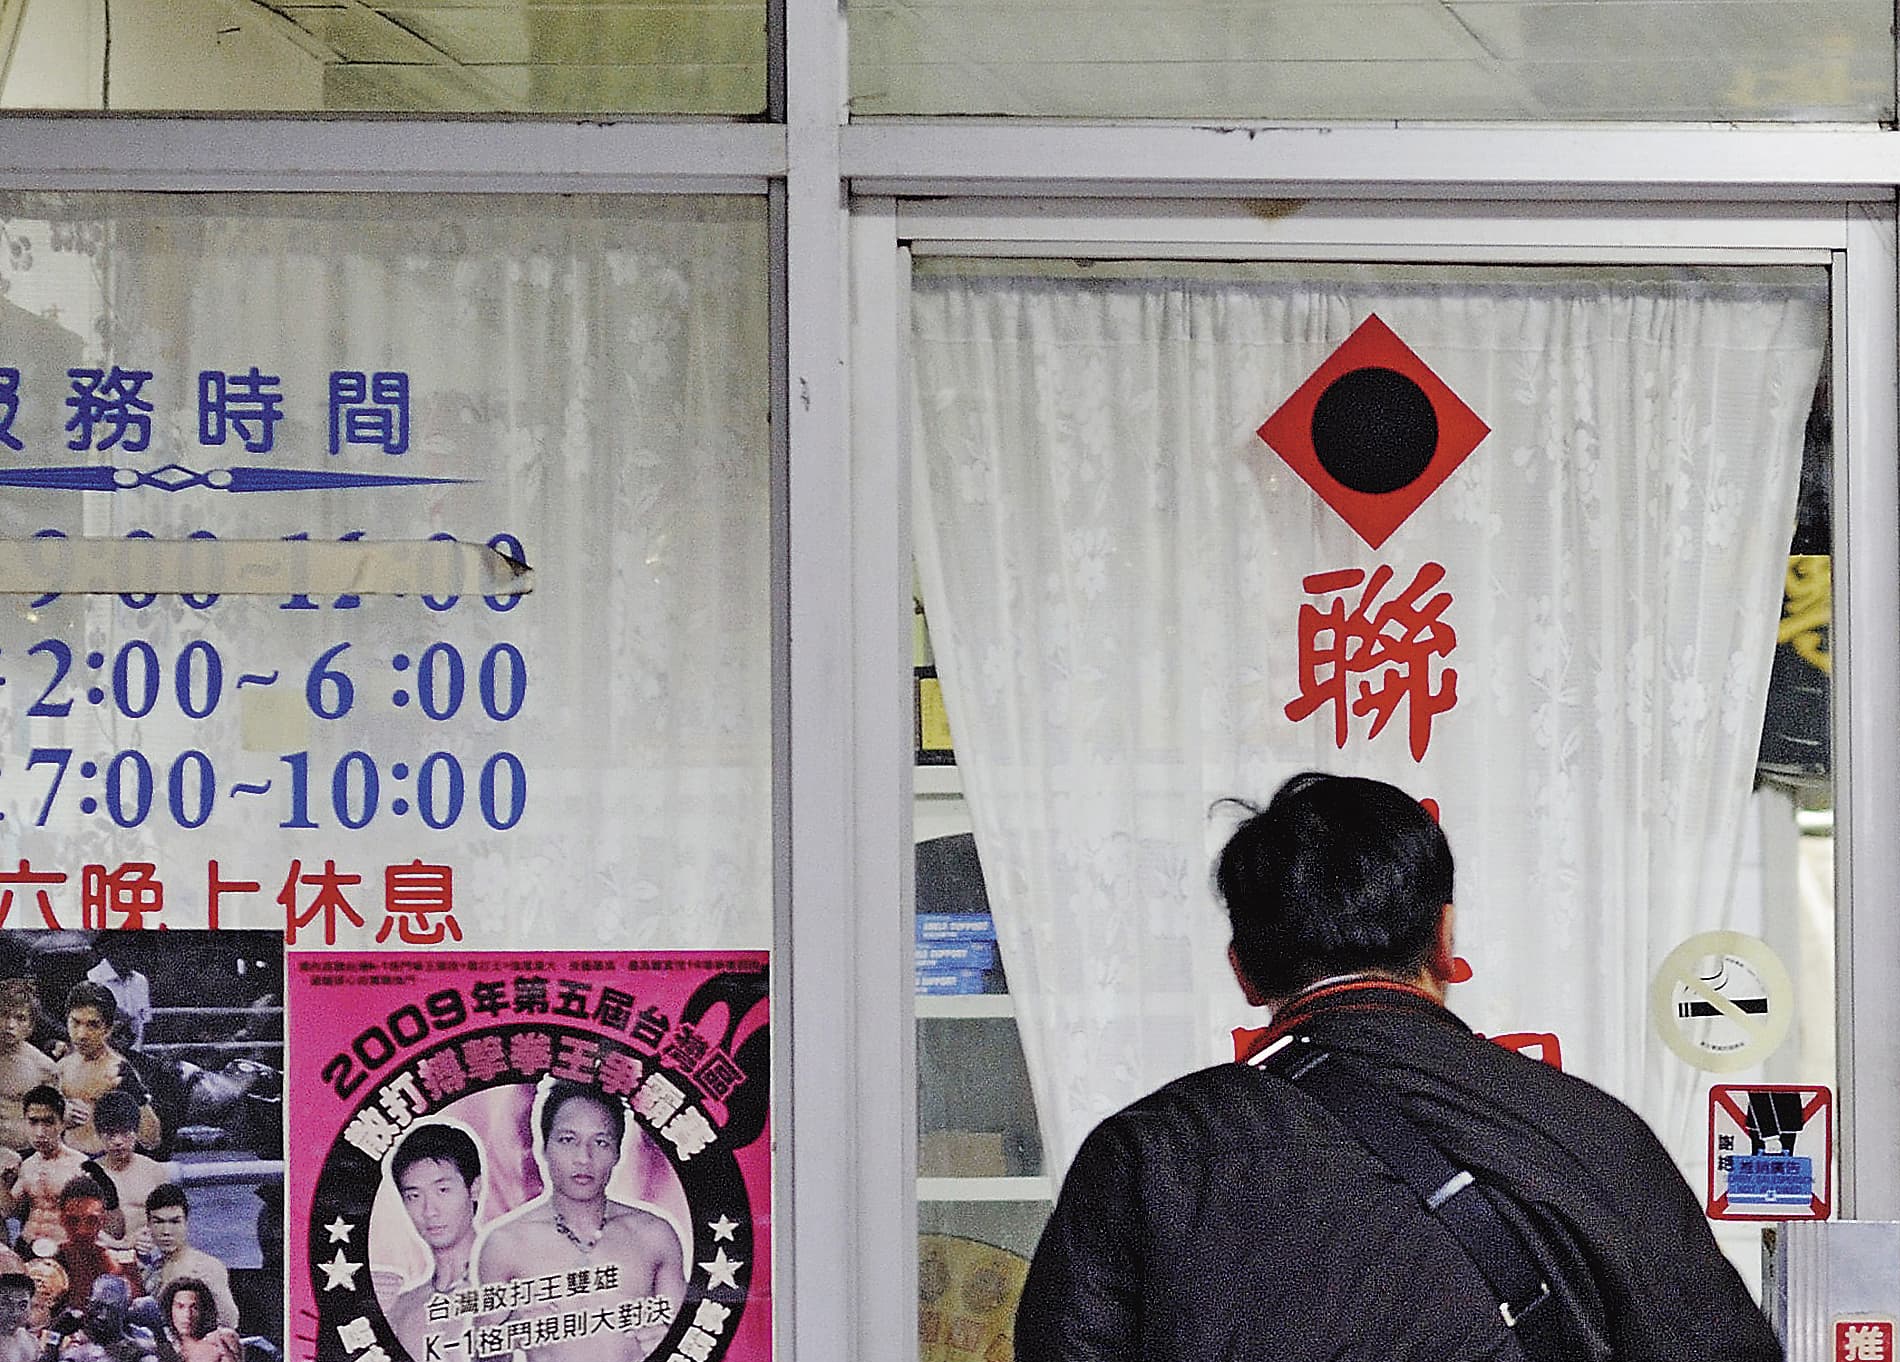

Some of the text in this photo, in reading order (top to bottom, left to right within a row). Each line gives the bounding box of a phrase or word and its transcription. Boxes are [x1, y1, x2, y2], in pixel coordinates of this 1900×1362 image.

[0, 367, 411, 455] 務時間
[1284, 561, 1458, 763] 聯
[427, 1264, 620, 1323] 台灣散打王雙雄
[1844, 1325, 1885, 1361] 推
